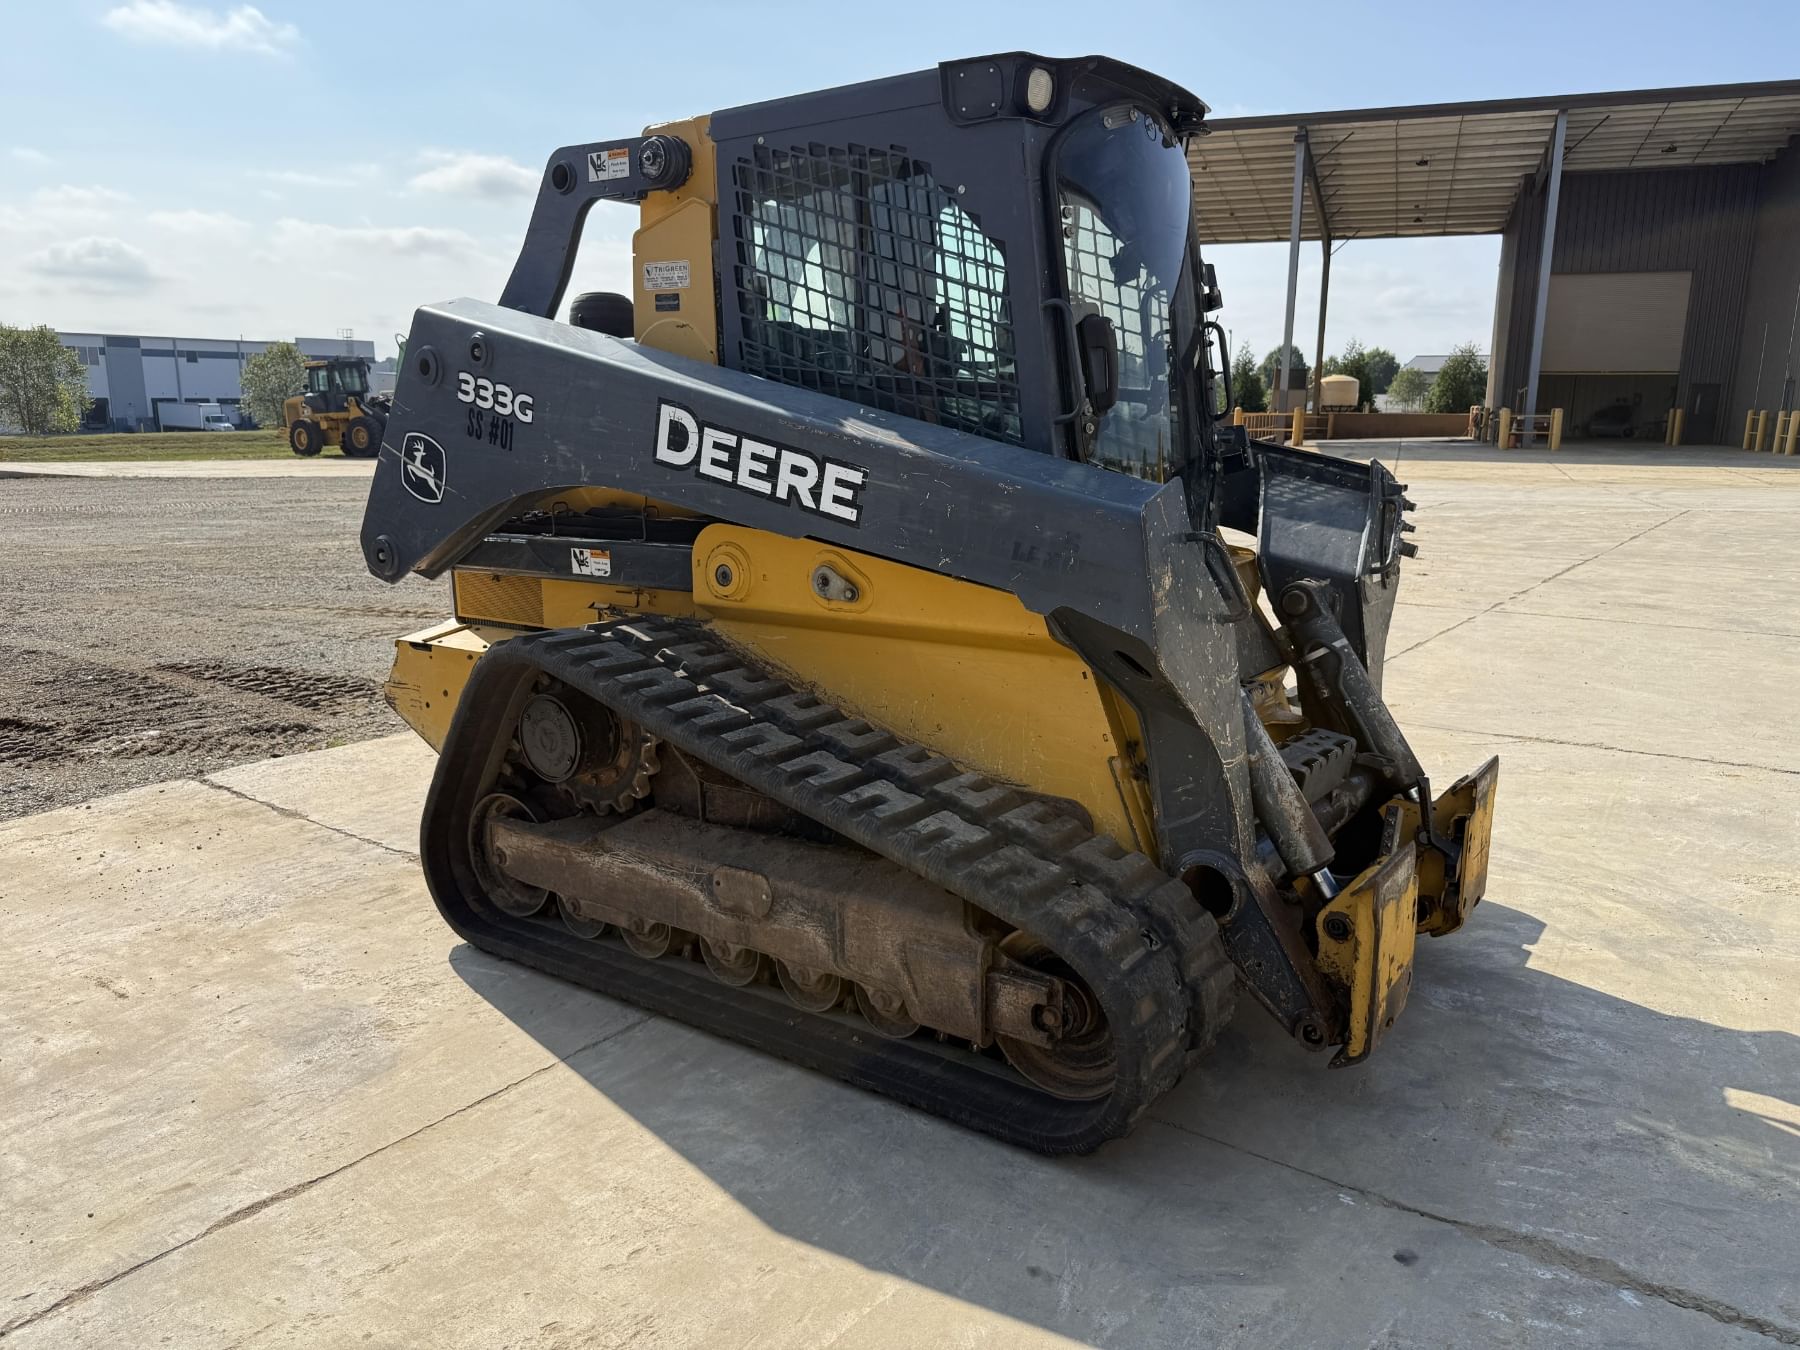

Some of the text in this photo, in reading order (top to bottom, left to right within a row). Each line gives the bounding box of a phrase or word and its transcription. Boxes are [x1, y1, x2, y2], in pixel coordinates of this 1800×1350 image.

[457, 371, 534, 424] 333G
[467, 407, 514, 452] SS #01
[656, 403, 865, 522] DEERE
